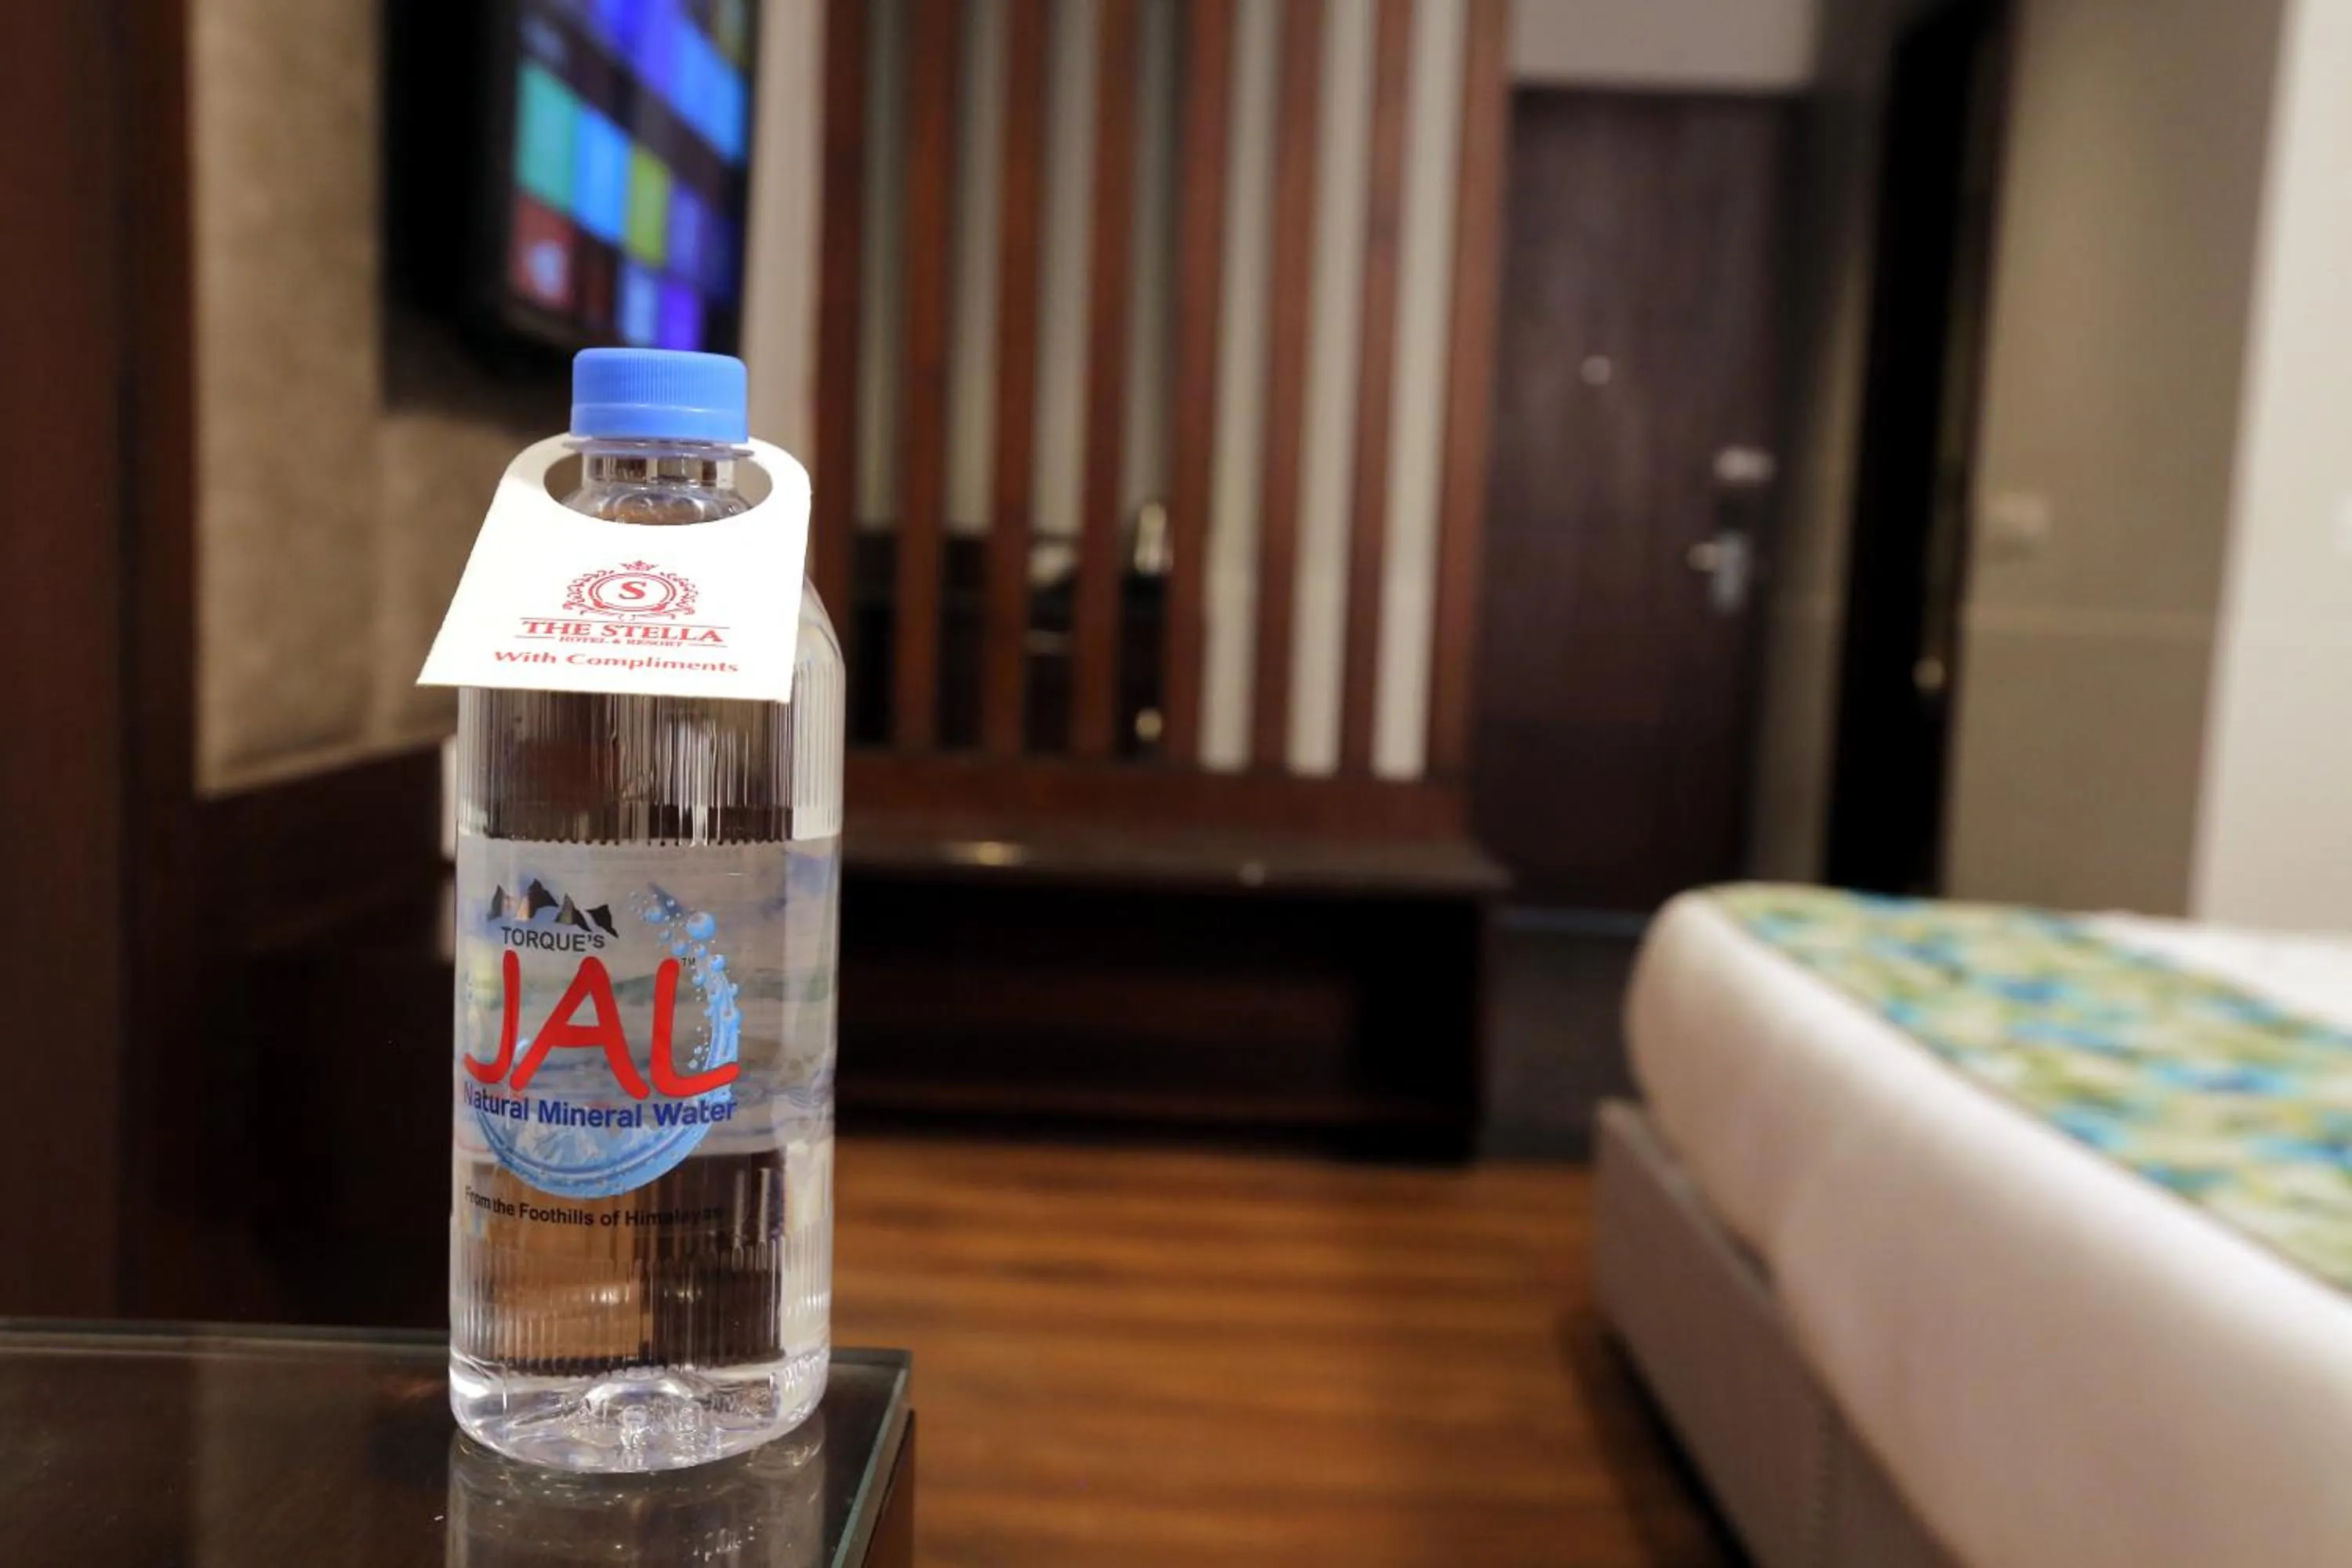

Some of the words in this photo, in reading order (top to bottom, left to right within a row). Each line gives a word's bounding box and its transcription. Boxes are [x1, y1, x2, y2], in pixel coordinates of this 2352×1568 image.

[618, 580, 647, 600] S
[521, 620, 592, 635] THE
[601, 623, 724, 642] STELLA
[495, 651, 557, 664] With
[565, 653, 739, 672] Compliments
[463, 949, 742, 1099] JAL
[463, 1080, 530, 1122] Natural
[538, 1099, 643, 1128] Mineral
[652, 1099, 738, 1127] Water
[465, 1185, 492, 1210] From
[493, 1197, 515, 1217] the
[519, 1202, 594, 1226] Foothills
[600, 1210, 621, 1227] of
